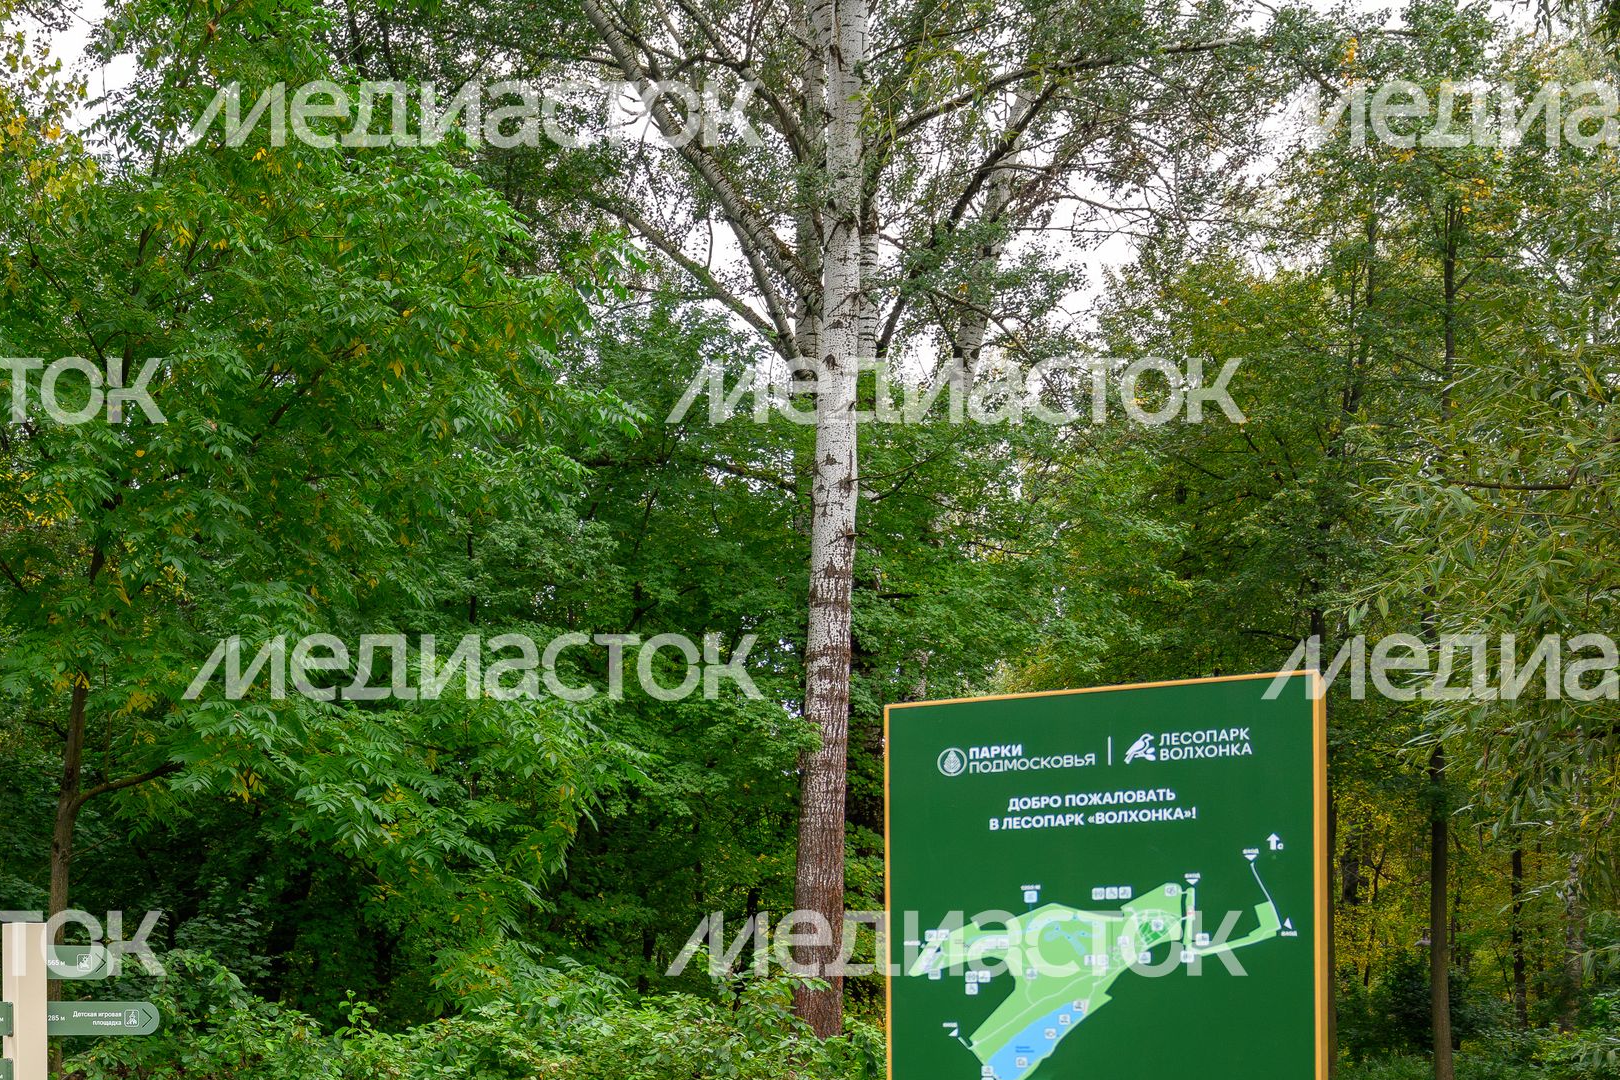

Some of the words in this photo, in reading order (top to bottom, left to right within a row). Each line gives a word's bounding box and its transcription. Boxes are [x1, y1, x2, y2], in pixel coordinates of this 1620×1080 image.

[1159, 727, 1251, 747] ЛЕСОПАРК
[969, 744, 1023, 760] ПАРКИ
[1159, 742, 1253, 762] ВОЛХОНКА
[969, 753, 1096, 774] ПОДМОСКОВЬЯ
[1007, 795, 1062, 812] ДОБРО
[1065, 788, 1176, 808] ПОЖАЛОВАТЬ
[989, 818, 999, 831] В
[1001, 812, 1085, 829] ЛЕСОПАРК
[1087, 807, 1197, 825] «ВОЛХОНКА»!
[73, 1010, 97, 1018] Детская
